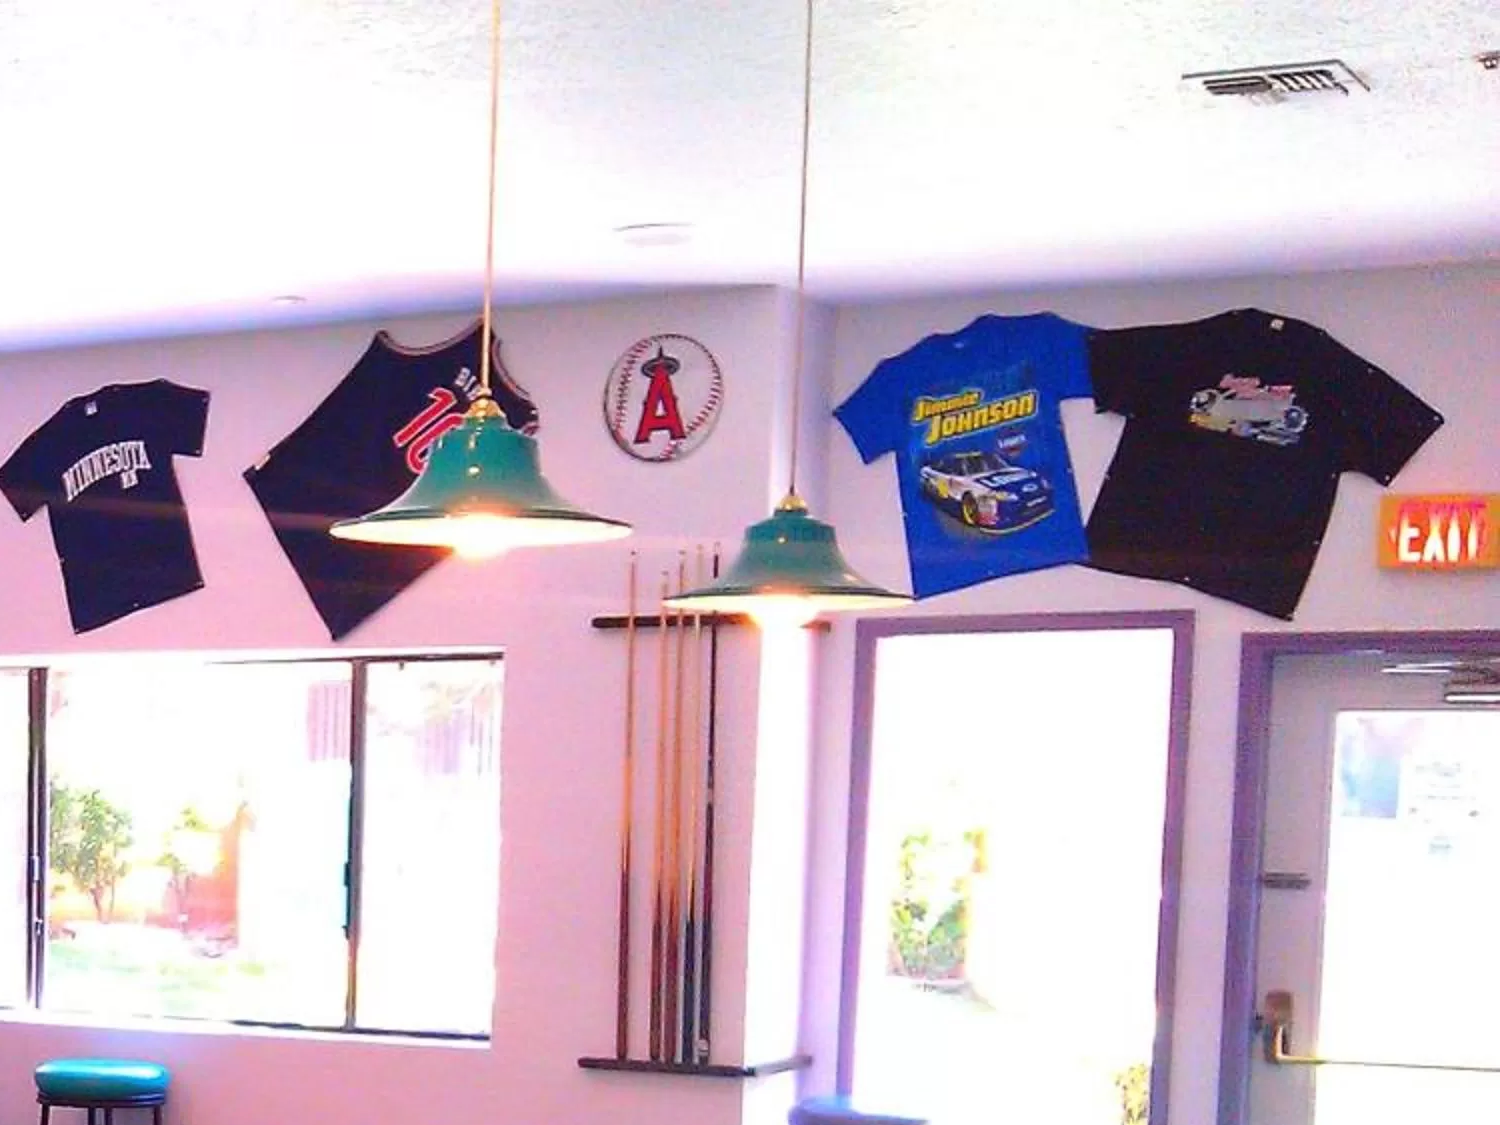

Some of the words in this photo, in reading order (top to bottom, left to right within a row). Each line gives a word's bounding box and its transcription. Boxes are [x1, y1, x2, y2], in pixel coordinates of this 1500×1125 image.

[634, 352, 686, 445] A
[62, 440, 152, 502] MINNESOTA
[1397, 503, 1486, 563] EXIT
